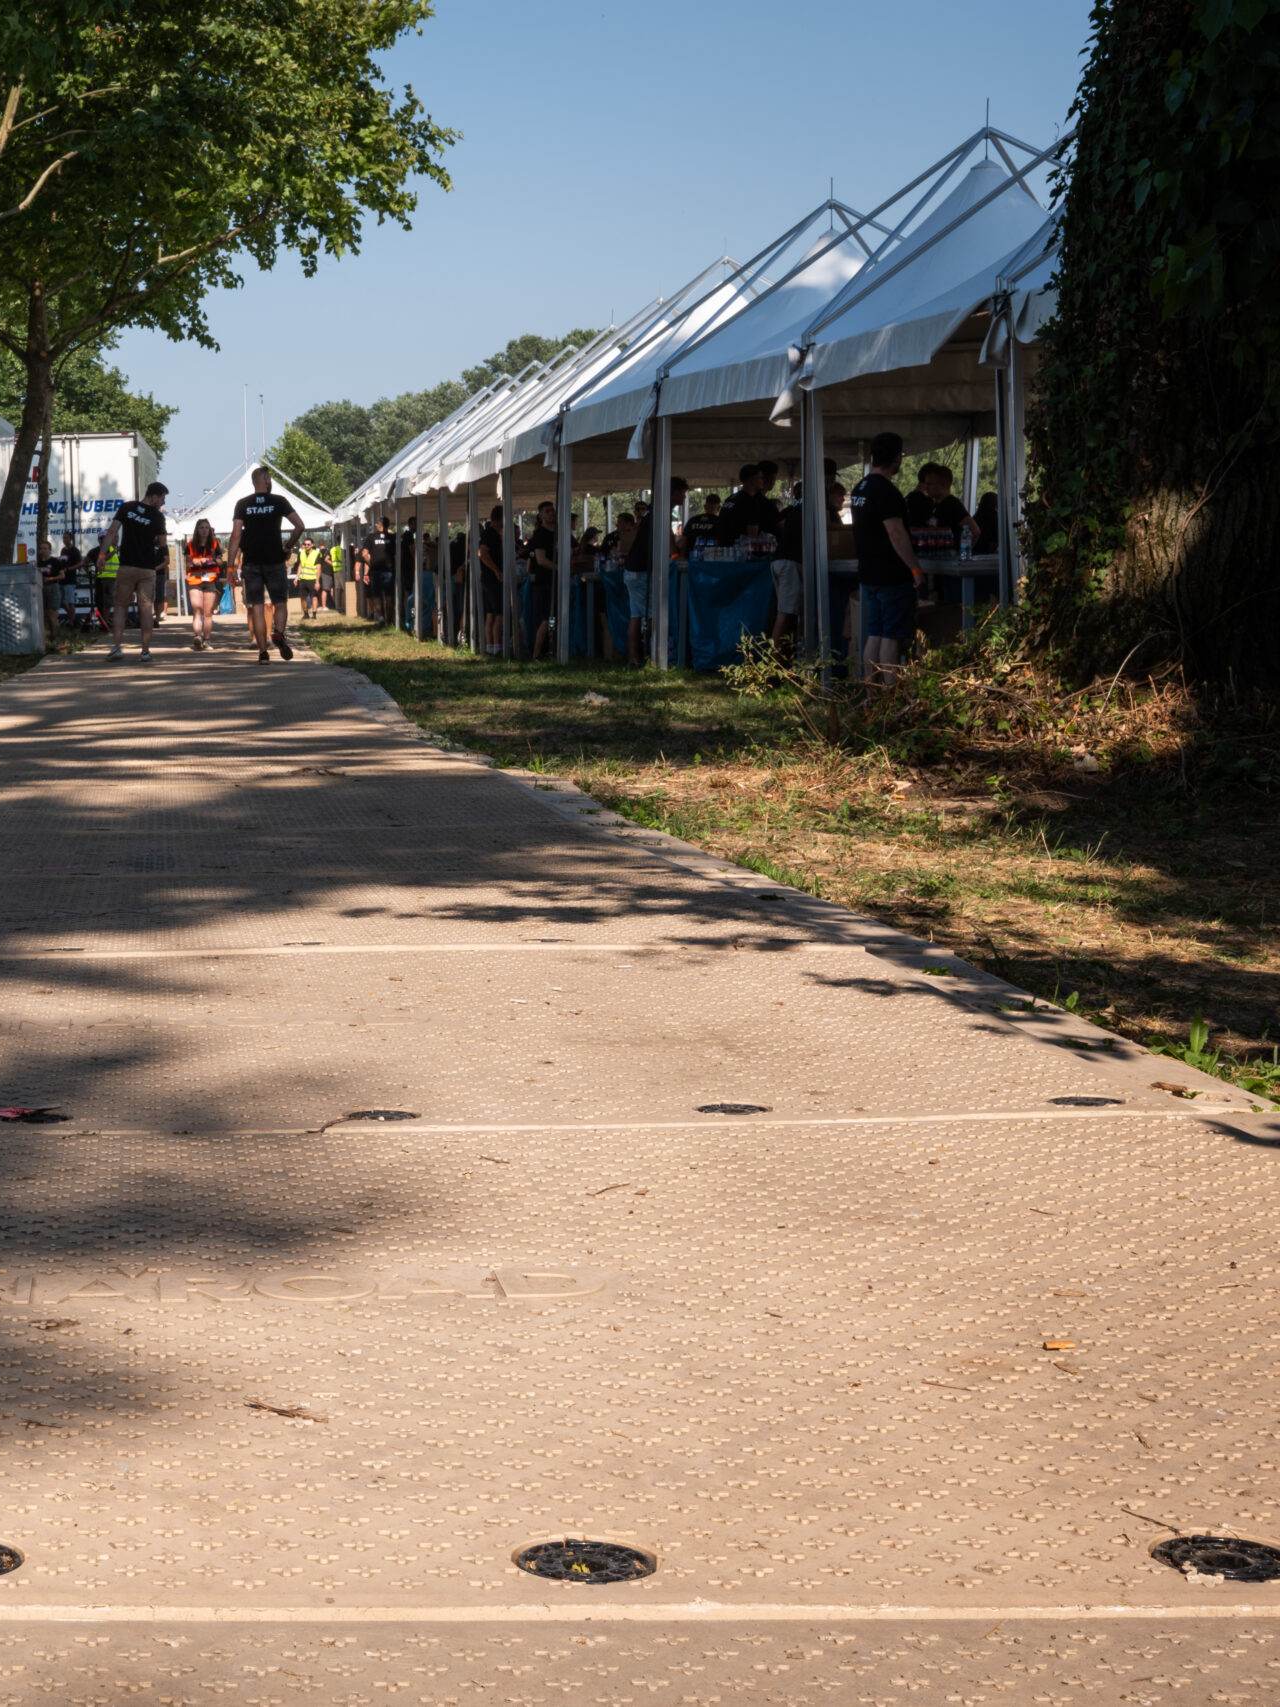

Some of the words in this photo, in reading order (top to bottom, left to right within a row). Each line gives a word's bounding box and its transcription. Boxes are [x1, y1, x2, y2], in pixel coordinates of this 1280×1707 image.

[22, 501, 68, 515] HENZ
[245, 505, 275, 515] STAFF
[127, 511, 152, 526] STAFF
